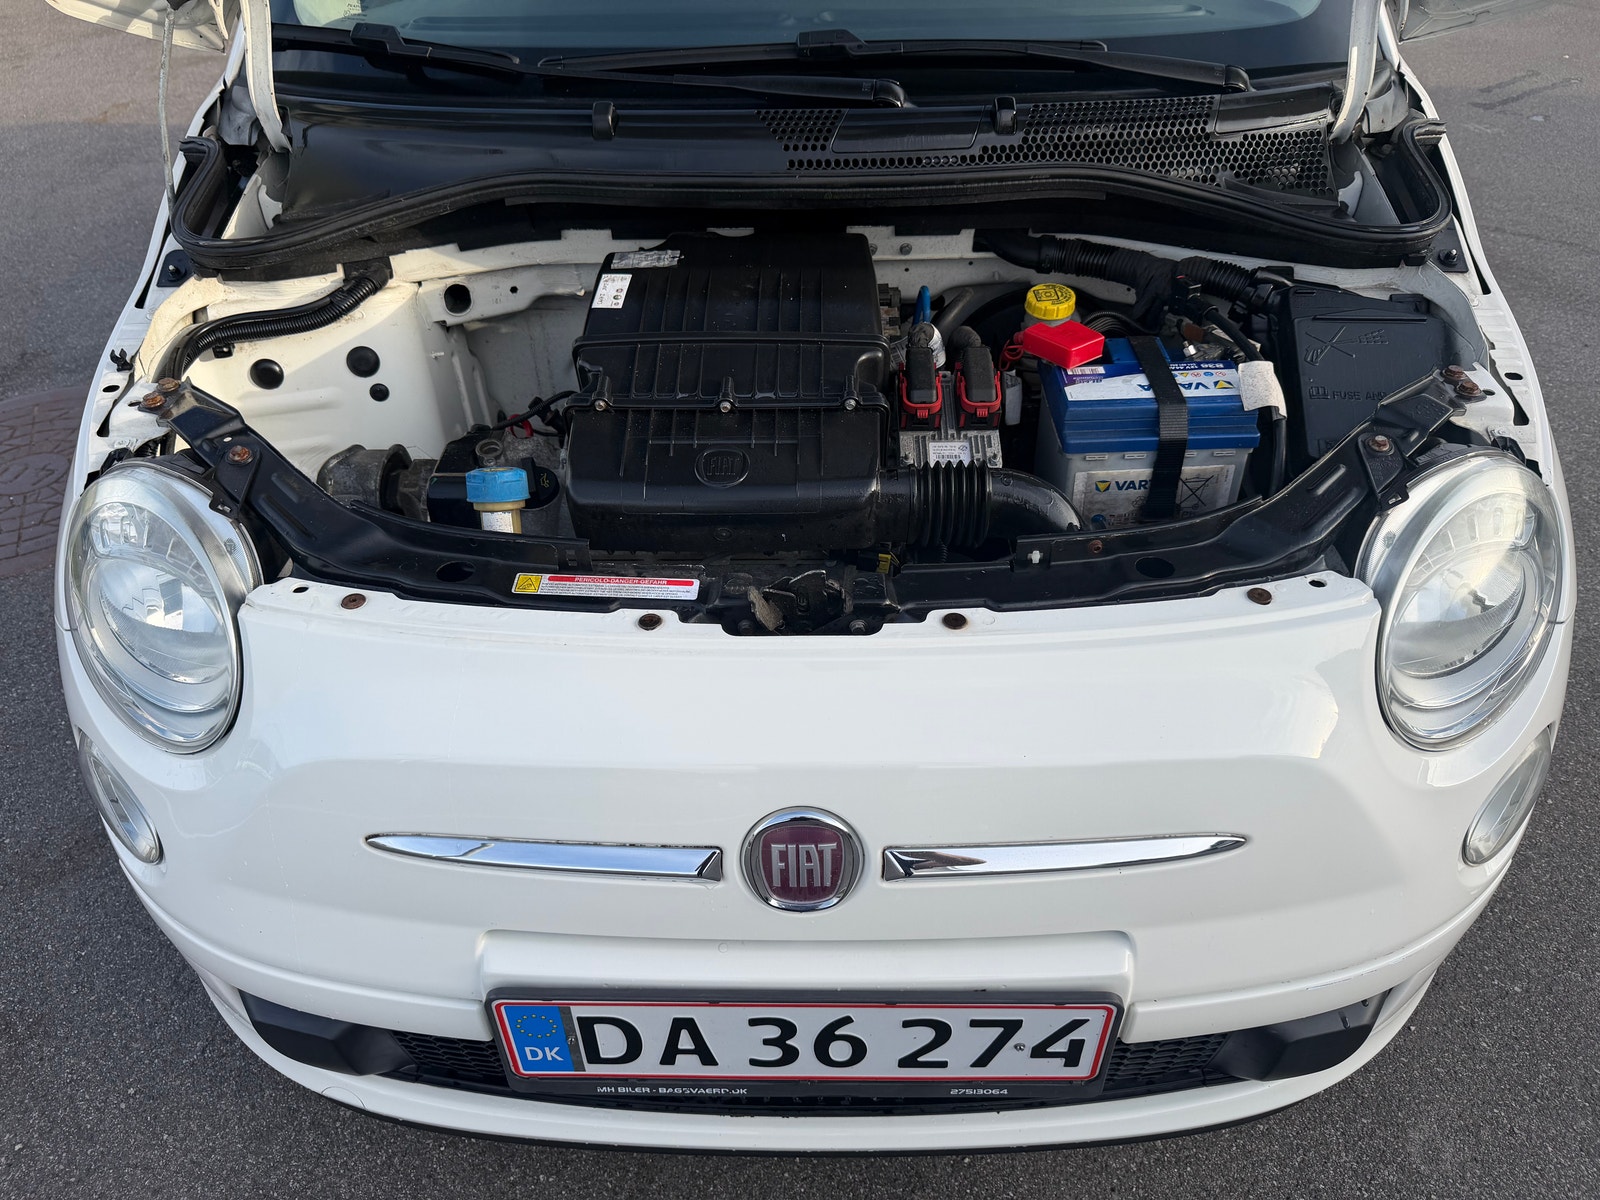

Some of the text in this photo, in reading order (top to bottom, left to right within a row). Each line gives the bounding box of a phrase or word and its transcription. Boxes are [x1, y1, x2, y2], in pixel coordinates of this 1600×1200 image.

[1332, 390, 1362, 401] FUSE
[706, 456, 741, 476] FIAT
[770, 842, 838, 888] FIAT
[576, 1014, 1091, 1069] DA 36 274
[523, 1045, 565, 1062] DK
[596, 1086, 615, 1094] MH
[617, 1086, 651, 1094] BILER
